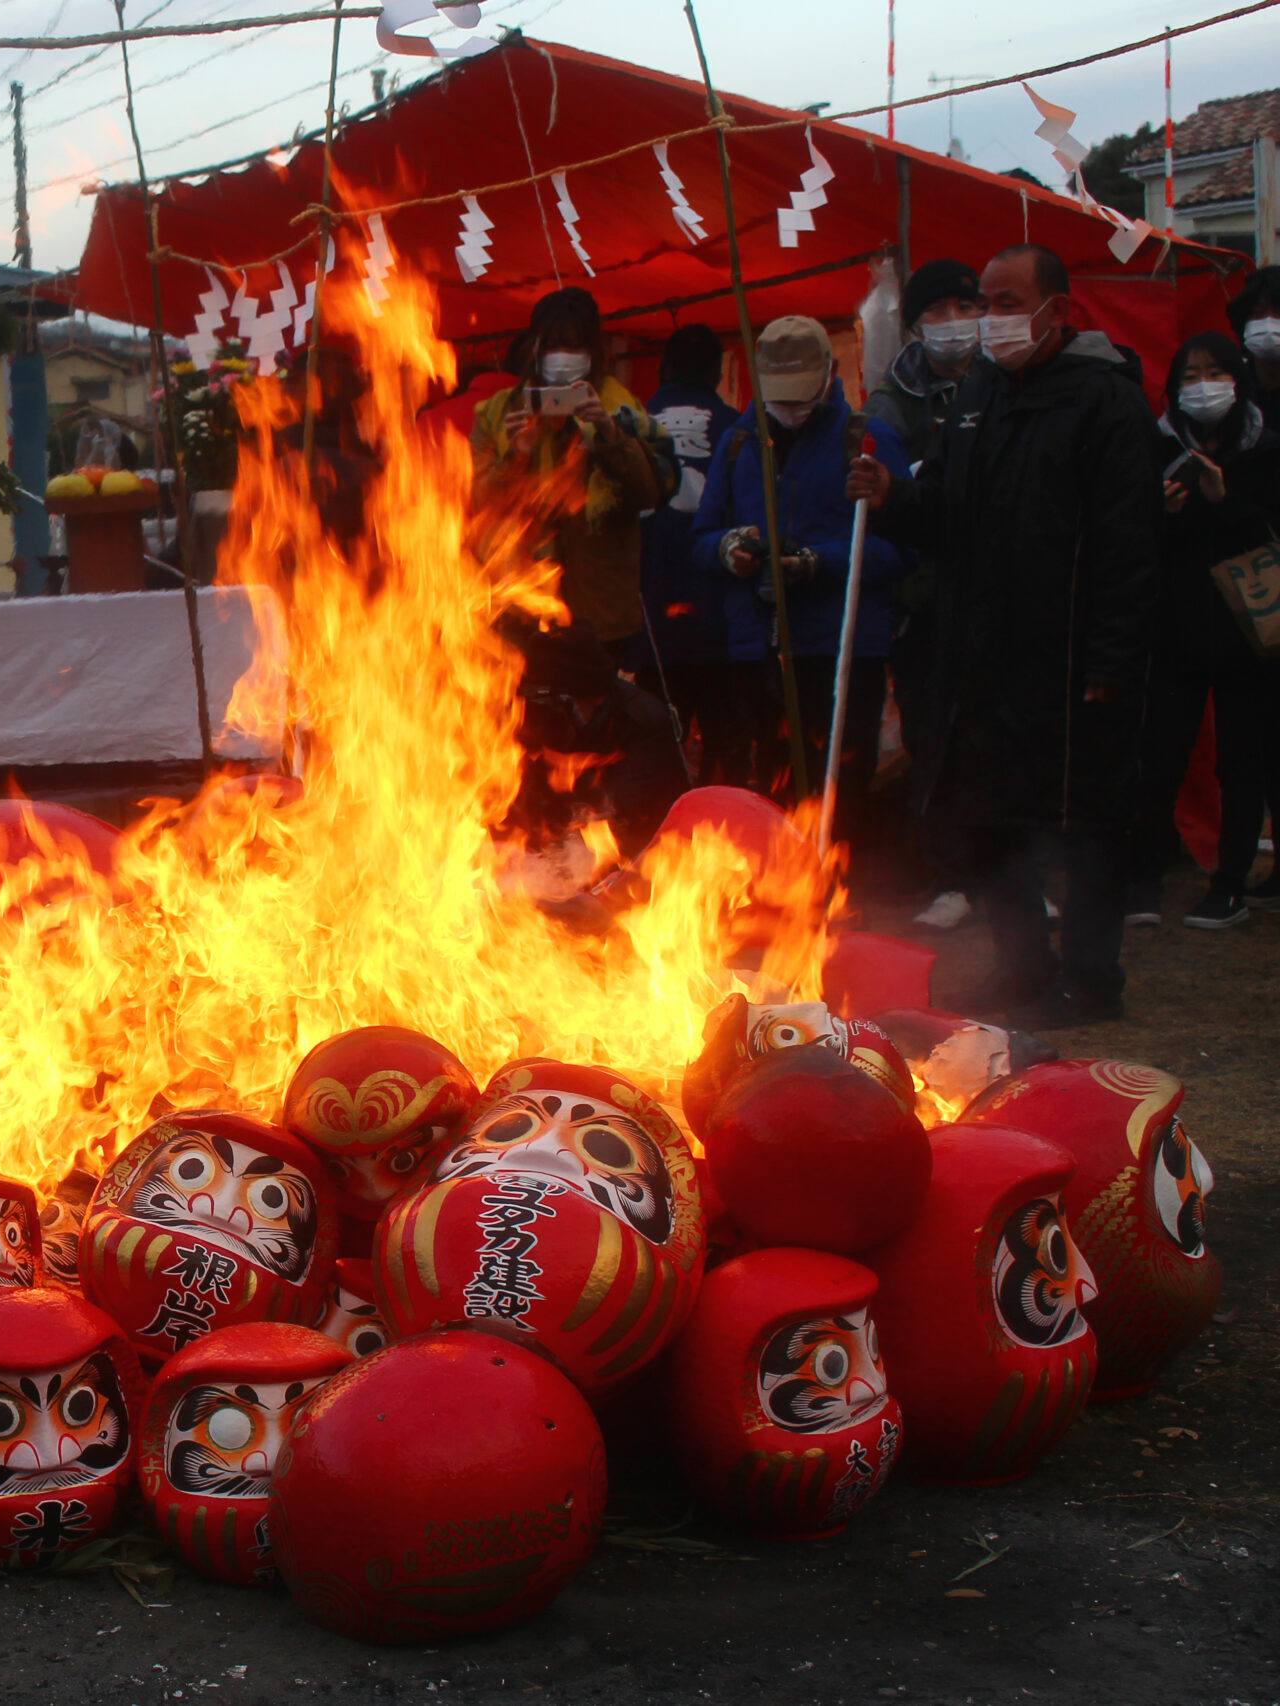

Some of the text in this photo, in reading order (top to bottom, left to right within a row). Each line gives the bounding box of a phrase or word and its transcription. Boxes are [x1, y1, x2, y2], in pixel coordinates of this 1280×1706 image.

[94, 1121, 183, 1208] 無病息災
[137, 1243, 238, 1352] 根岸
